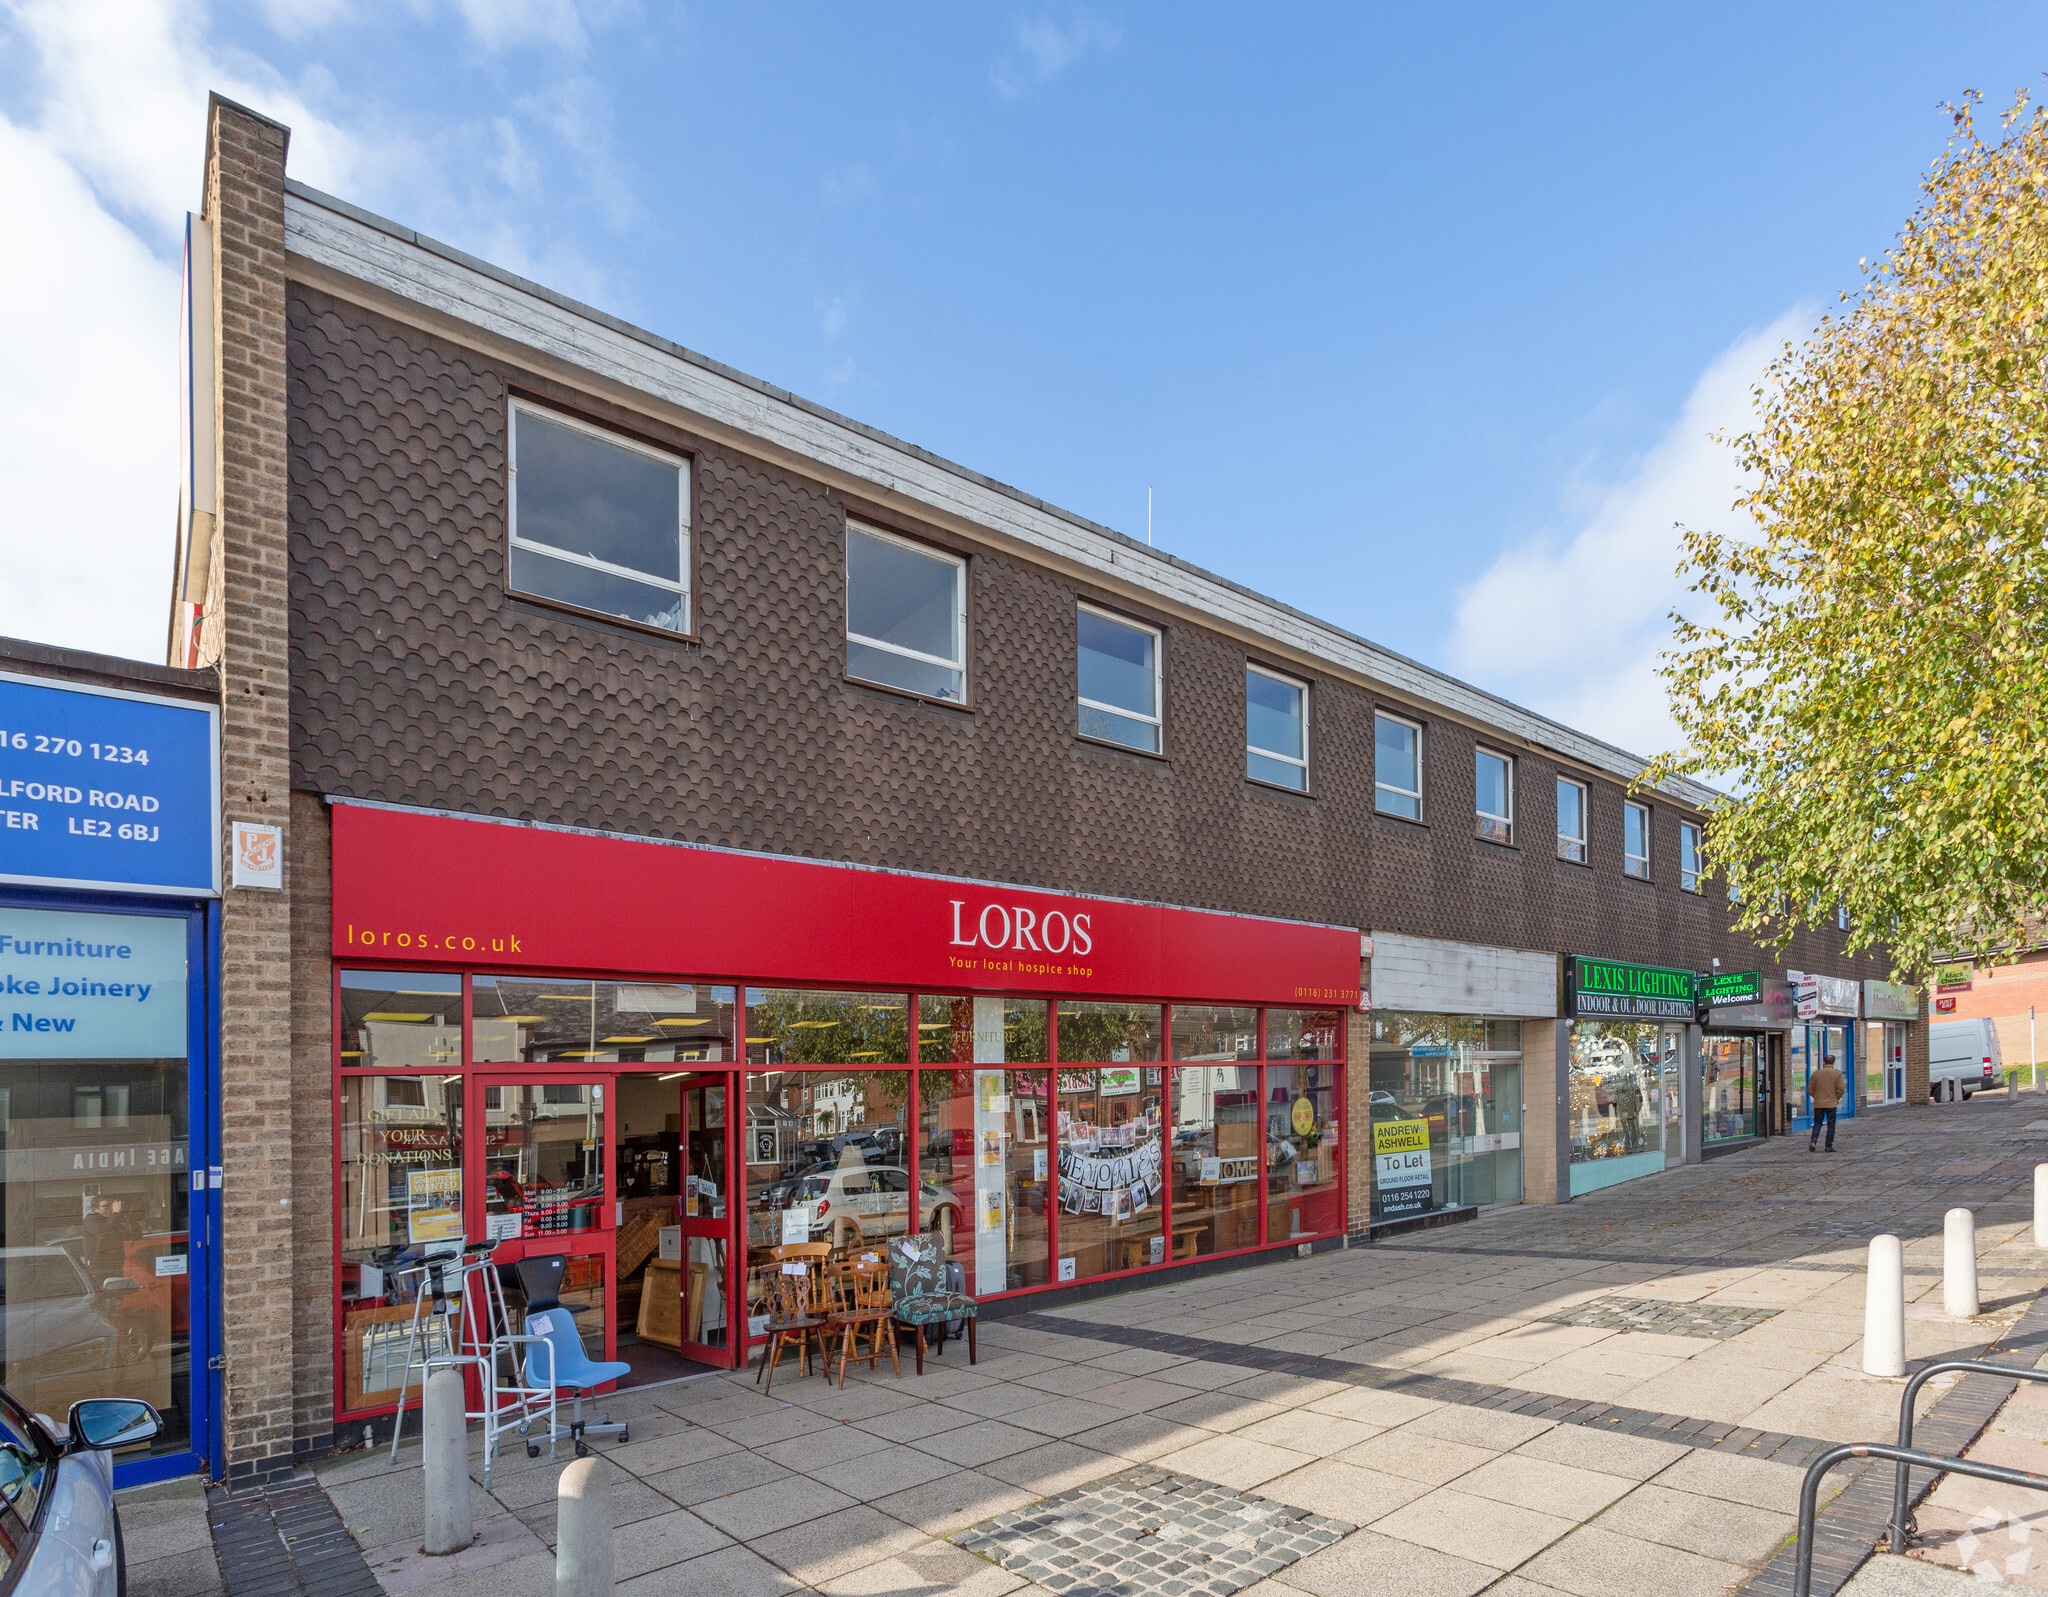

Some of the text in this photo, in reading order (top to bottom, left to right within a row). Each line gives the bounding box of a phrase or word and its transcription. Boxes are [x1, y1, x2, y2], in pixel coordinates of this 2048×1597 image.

[34, 735, 82, 757] 270
[90, 743, 149, 766] 1234
[89, 789, 160, 813] ROAD
[0, 810, 159, 842] ER LE2 6BJ
[949, 900, 1093, 956] LOROS
[348, 924, 522, 953] loros.co.uk
[0, 935, 132, 959] Furniture
[949, 956, 1093, 979] Your local hospice shop
[1583, 964, 1689, 997] LEXIS LIGHTING
[1713, 975, 1743, 986] LEXIS
[48, 977, 152, 1003] Joinery
[1294, 986, 1358, 999] (0116) 231 3771
[1705, 984, 1754, 997] LIGHTING
[1577, 994, 1611, 1012] INDOOR
[1612, 997, 1619, 1013] &
[1658, 1000, 1691, 1016] LIGHTING
[1712, 993, 1754, 1005] Welcome
[12, 1013, 76, 1032] New
[955, 1031, 1017, 1043] FURNITURE
[367, 1107, 438, 1122] GIFT AID
[379, 1129, 427, 1143] YOUR
[1377, 1124, 1419, 1138] ANDREW
[1378, 1136, 1424, 1150] ASHWELL
[1384, 1154, 1424, 1171] To Let
[414, 1180, 457, 1193] WANTED
[1379, 1176, 1399, 1185] GROUND
[1415, 1173, 1430, 1181] RETAIL
[1381, 1189, 1430, 1203] 0116 254 1220
[1383, 1201, 1422, 1212] andash.co.uk
